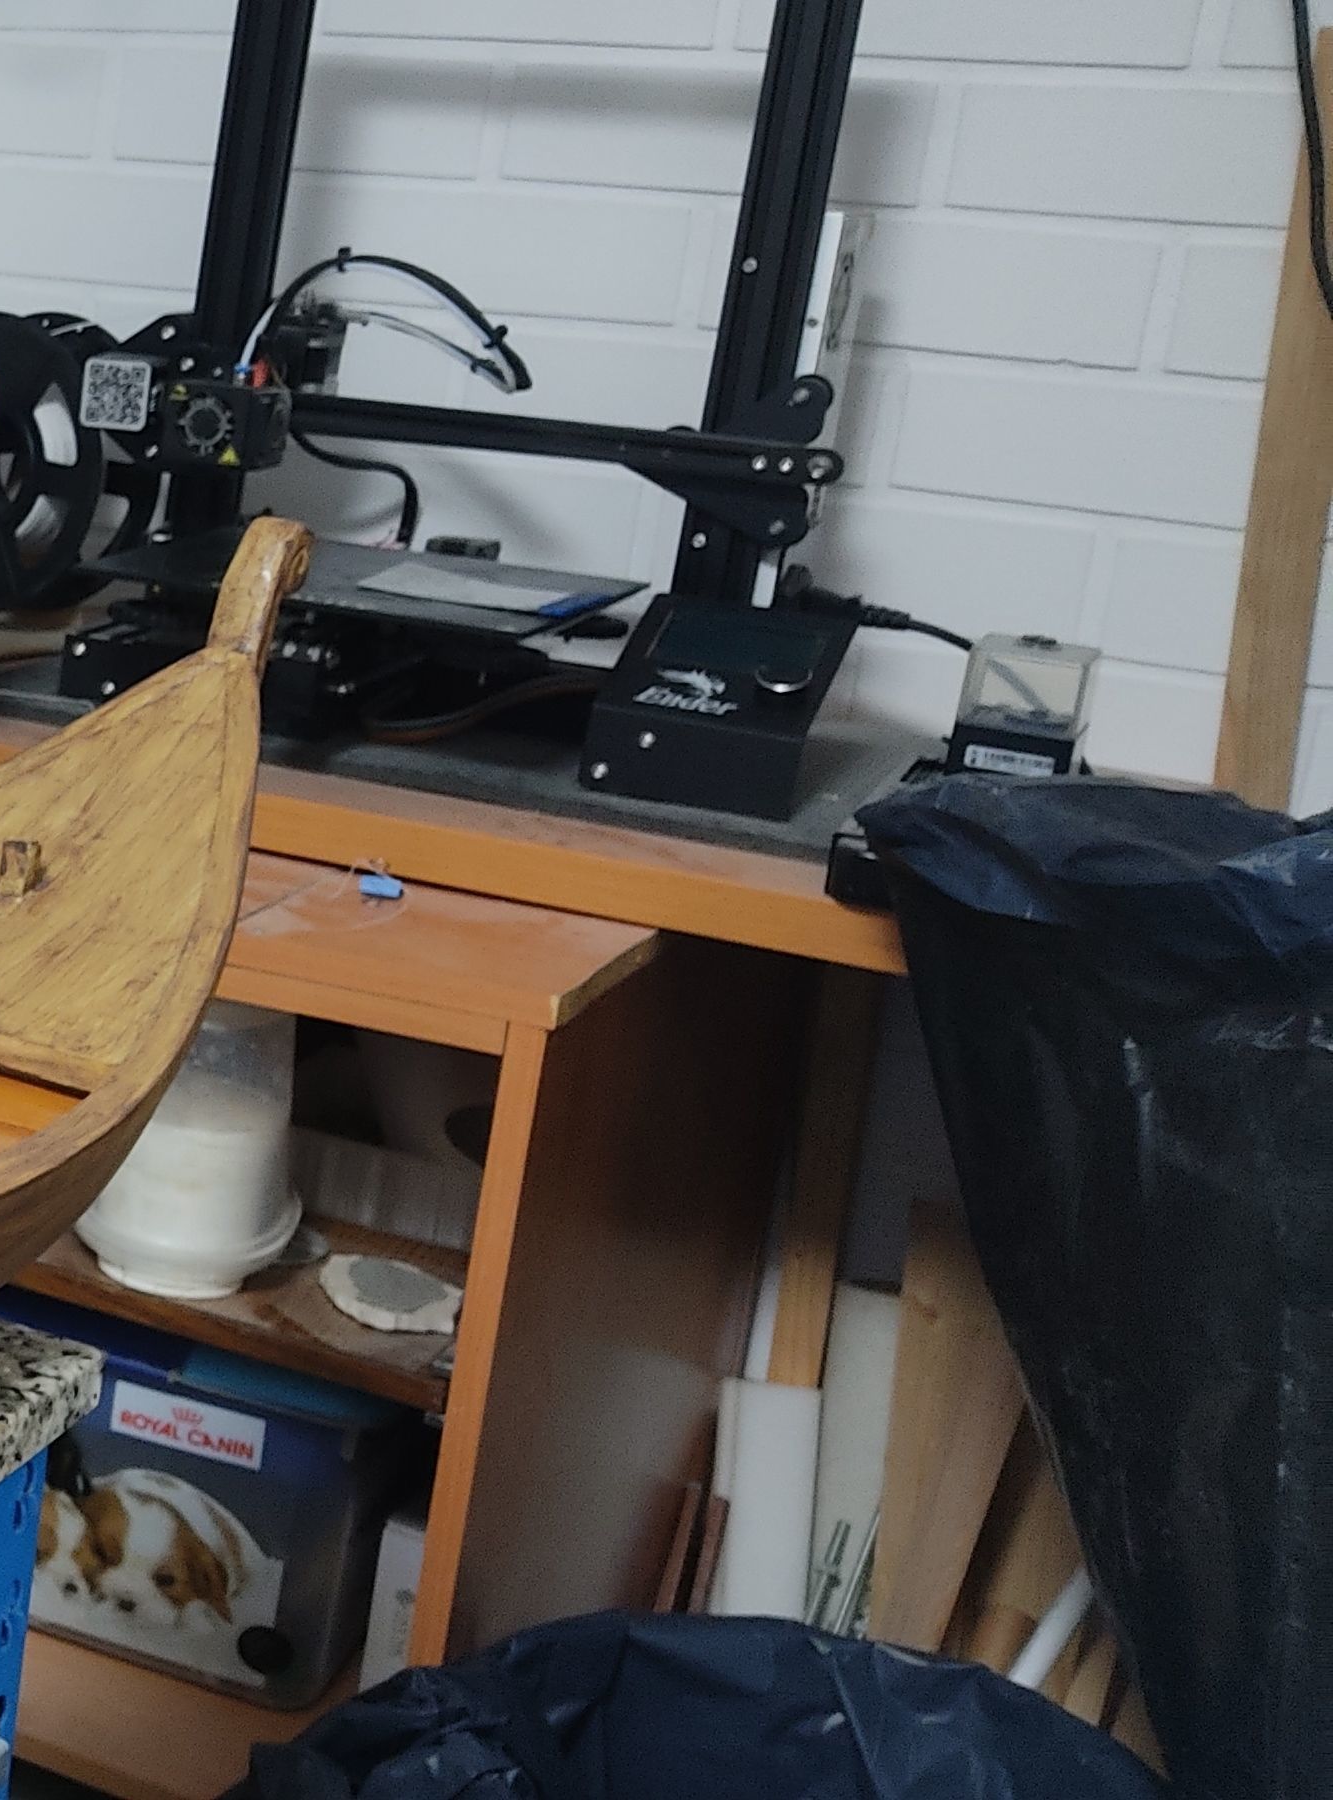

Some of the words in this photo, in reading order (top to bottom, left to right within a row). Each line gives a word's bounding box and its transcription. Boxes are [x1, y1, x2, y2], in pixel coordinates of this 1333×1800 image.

[632, 685, 738, 716] Ender
[120, 1409, 181, 1441] ROYAL
[187, 1428, 254, 1460] CANIN
